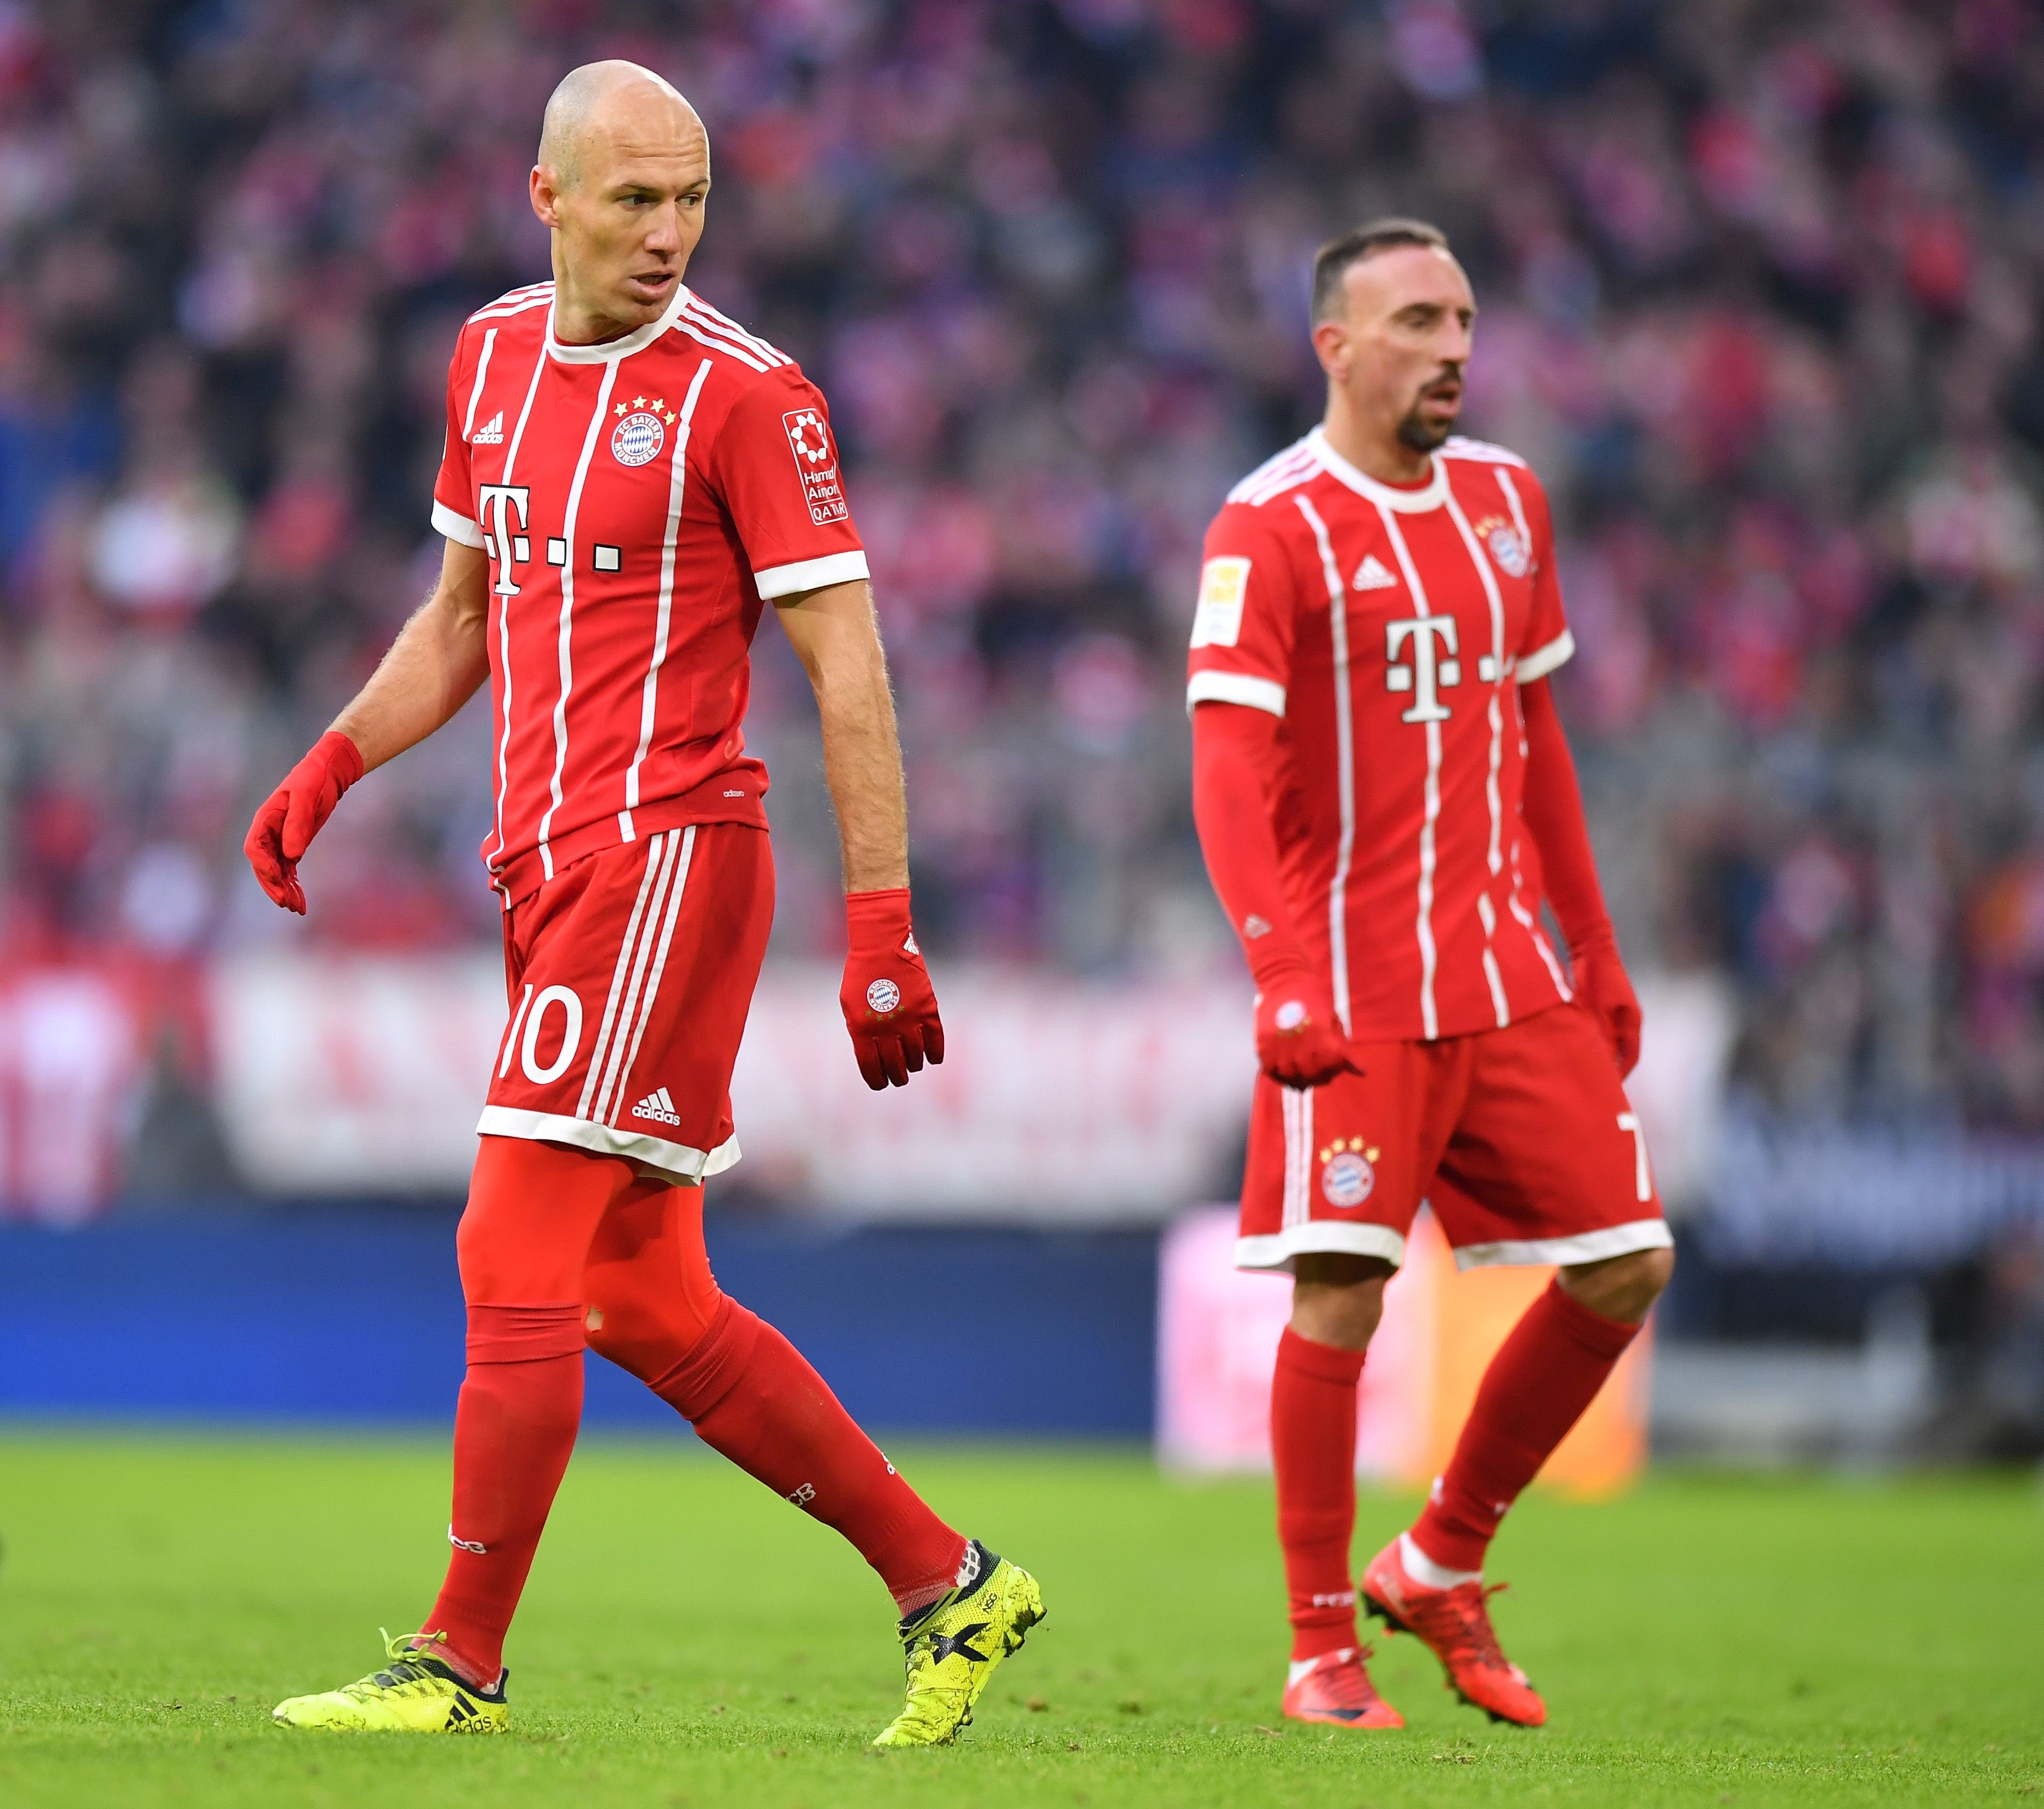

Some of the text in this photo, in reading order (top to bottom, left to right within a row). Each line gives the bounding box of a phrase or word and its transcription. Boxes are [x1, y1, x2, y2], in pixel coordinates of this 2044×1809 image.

[472, 433, 504, 444] adidas
[618, 415, 661, 440] FC BAYERN
[498, 983, 583, 1085] 10
[631, 1106, 681, 1126] adidas
[1615, 1112, 1653, 1203] 7
